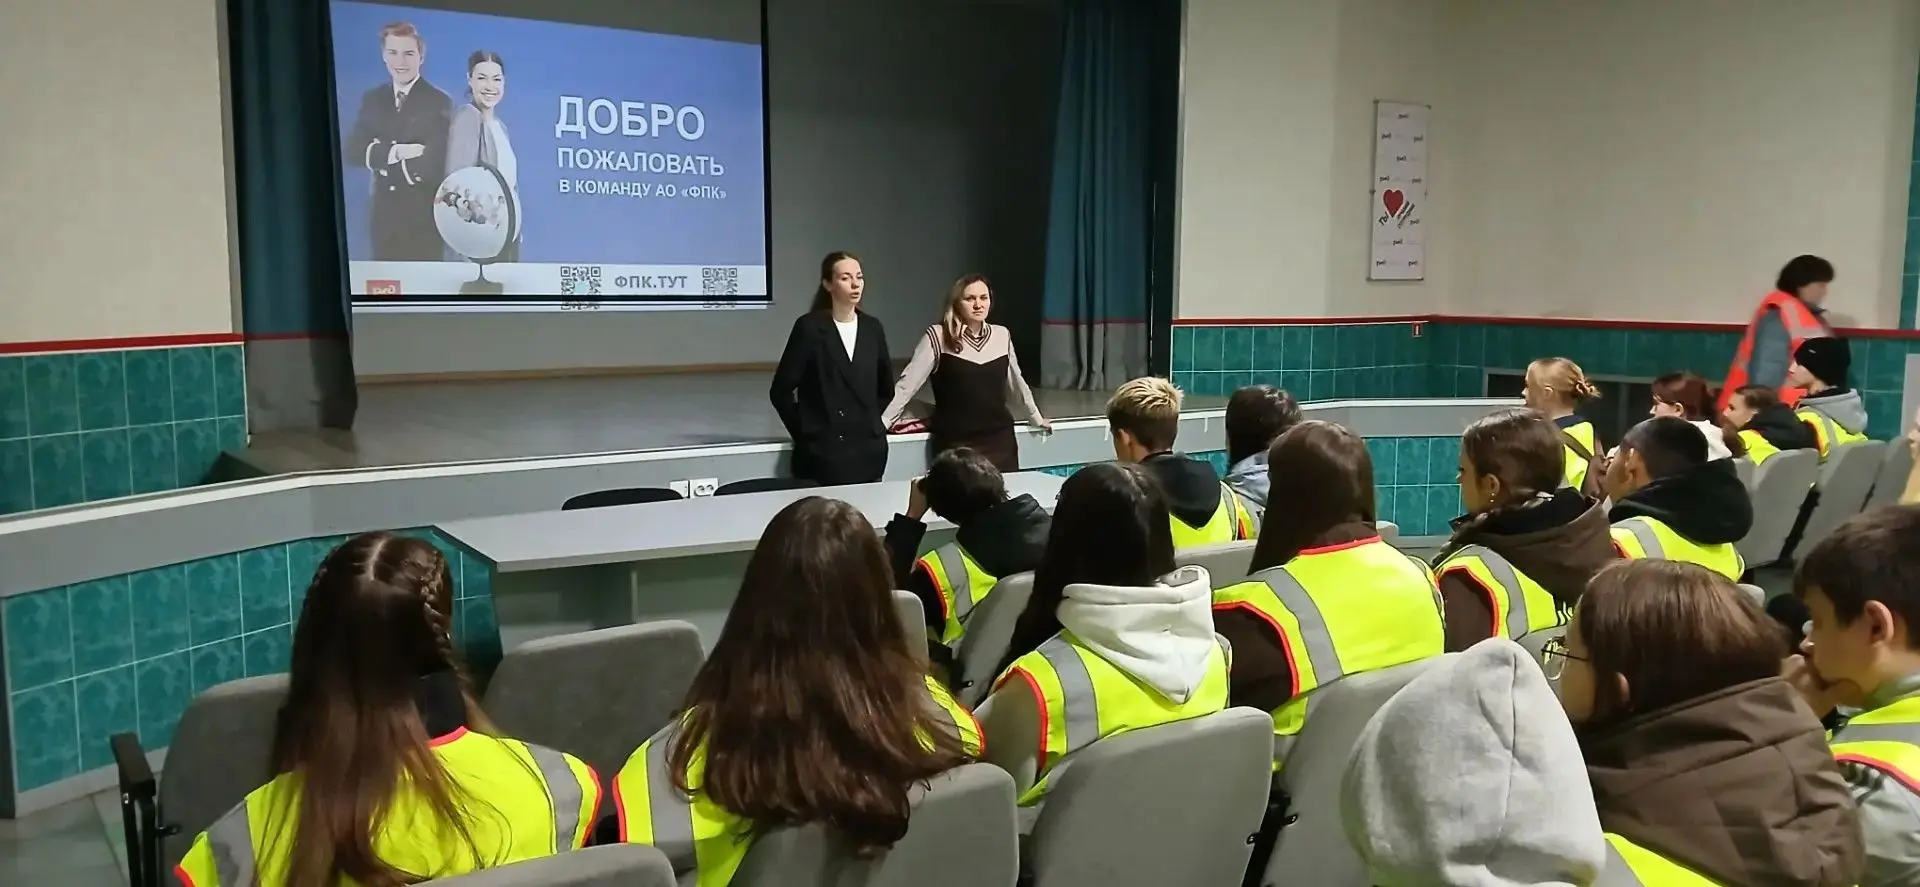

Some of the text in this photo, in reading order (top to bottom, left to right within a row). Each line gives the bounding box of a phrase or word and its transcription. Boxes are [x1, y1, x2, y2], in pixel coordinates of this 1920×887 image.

[555, 95, 705, 141] ДОБРО
[557, 147, 725, 176] ПОЖАЛОВАТЬ
[559, 179, 728, 200] В КОМАНДУ АО «ФПК»
[614, 275, 688, 289] ФПК.ТУТ
